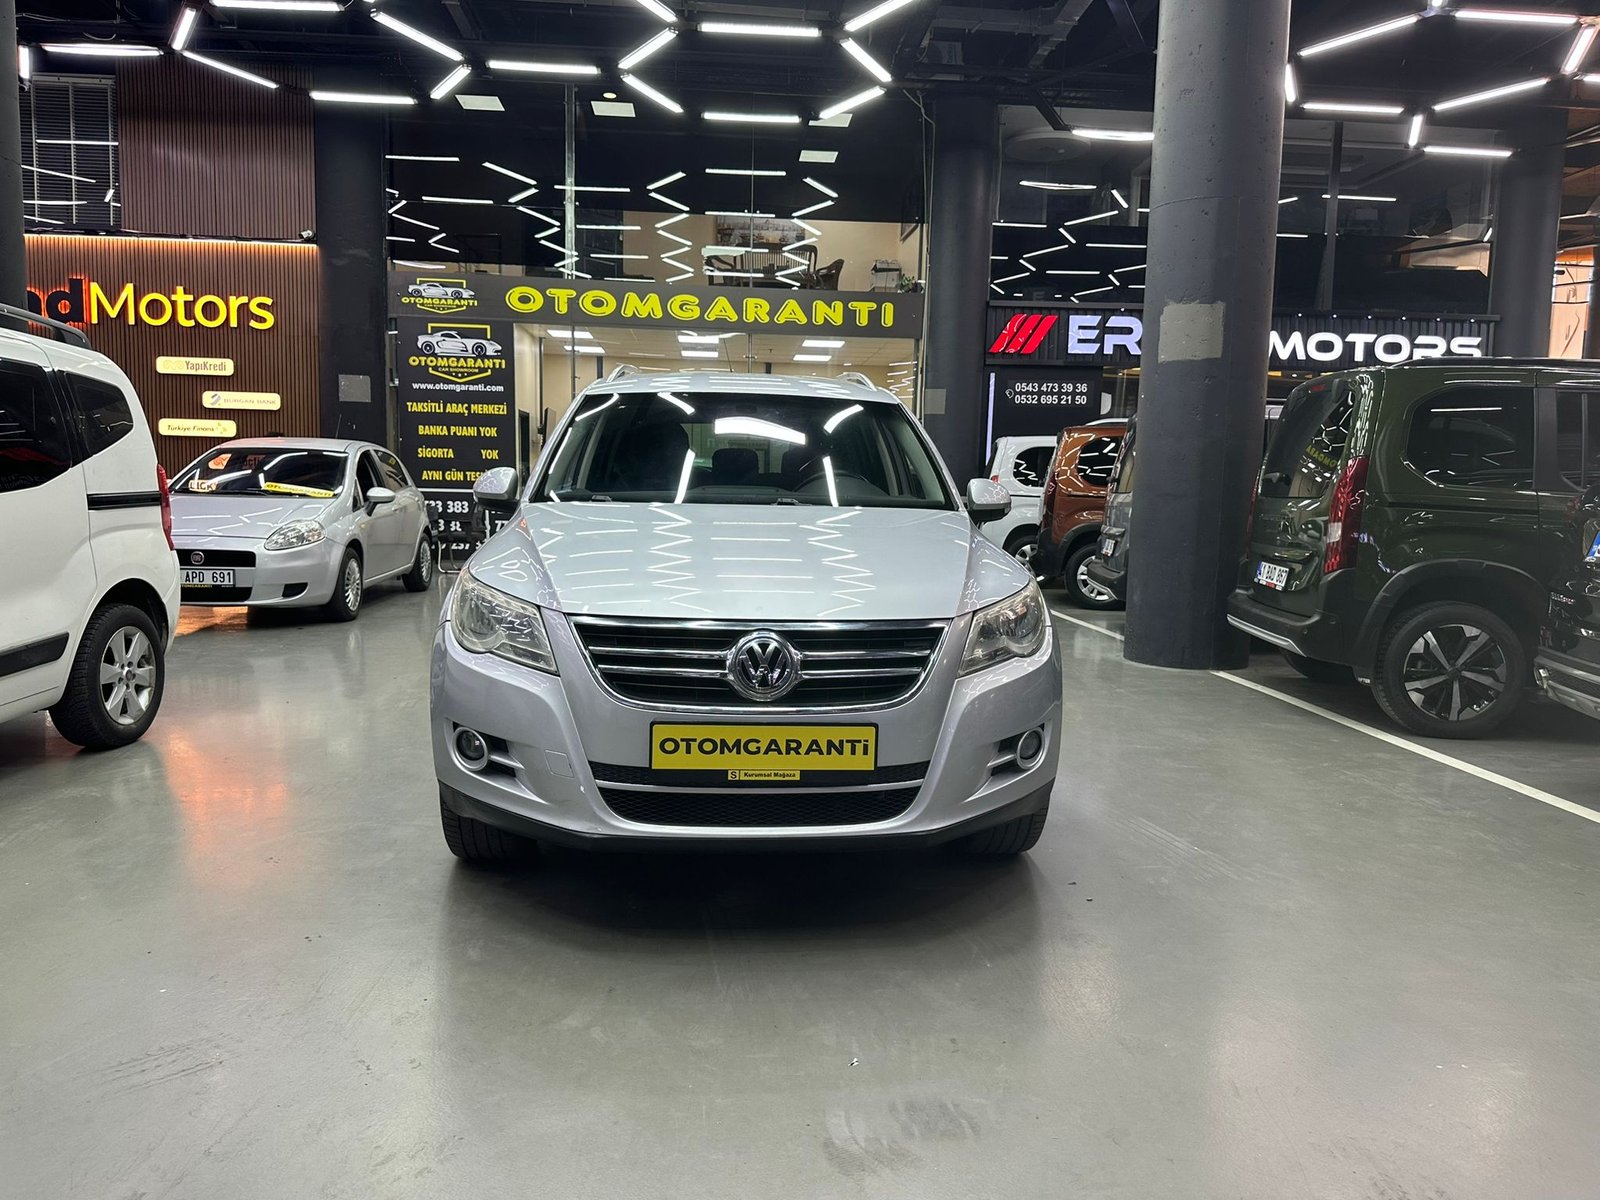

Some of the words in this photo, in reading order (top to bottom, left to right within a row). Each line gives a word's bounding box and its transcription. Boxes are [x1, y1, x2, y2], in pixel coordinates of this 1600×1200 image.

[401, 297, 478, 306] OTOMGARANTI
[505, 285, 894, 327] OTOMGARANTI
[1268, 330, 1482, 362] MOTORS
[408, 356, 506, 368] OTOMGARANTI
[412, 382, 504, 392] www.otomgaranti.com
[1014, 382, 1039, 392] 0543
[1040, 383, 1059, 392] 473
[1060, 383, 1073, 392] 39
[1075, 383, 1088, 392] 36
[1014, 394, 1038, 404] 0532
[1040, 395, 1058, 404] 695
[1060, 395, 1072, 404] 21
[1074, 395, 1087, 404] 50
[406, 400, 444, 413] TAKSİTLİ
[445, 402, 469, 416] ARAÇ
[470, 402, 507, 415] MERKEZİ
[418, 425, 448, 436] BANKA
[450, 426, 477, 437] PUANI
[479, 427, 497, 437] YOK
[417, 445, 454, 459] SİGORTA
[481, 449, 499, 460] YOK
[422, 470, 443, 481] AYNI
[445, 468, 464, 481] GÜN
[446, 500, 469, 513] 383
[184, 570, 205, 583] APD
[211, 571, 232, 584] 691
